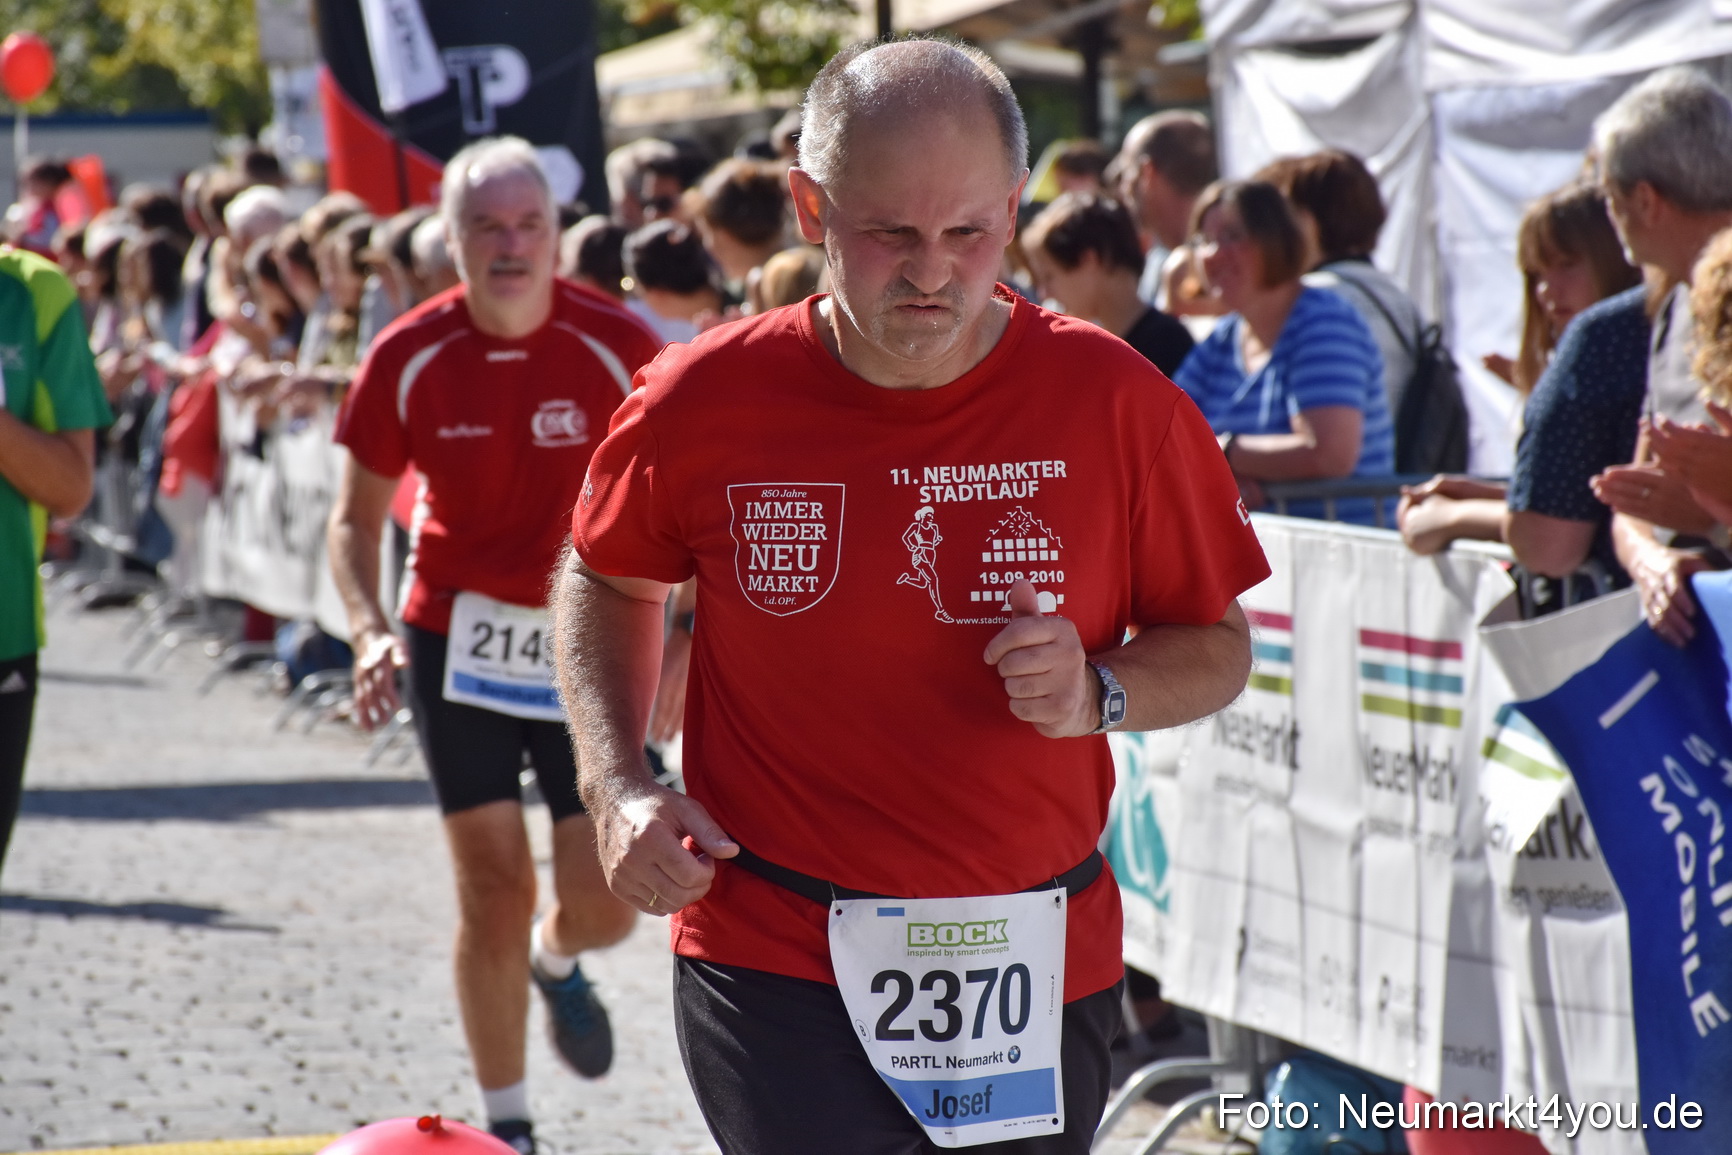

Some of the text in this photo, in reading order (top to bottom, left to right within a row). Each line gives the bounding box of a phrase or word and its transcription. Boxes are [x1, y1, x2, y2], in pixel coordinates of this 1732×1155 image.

[890, 460, 1067, 485] 11. NEUMARKTER
[761, 489, 807, 498] 850 Jahre
[919, 480, 1039, 503] STADTLAUF
[745, 501, 824, 519] IMMER
[741, 523, 827, 541] WIEDER
[748, 543, 820, 571] NEU
[747, 574, 819, 592] MARKT
[777, 596, 797, 605] OPf.
[469, 621, 553, 667] 214
[1639, 772, 1731, 1038] MOBILE
[907, 918, 1009, 947] BOCK
[906, 946, 1010, 958] inspired by smart concepts
[870, 963, 1031, 1042] 2370
[890, 1052, 1004, 1069] PARTL Neumarkt
[924, 1084, 993, 1119] Josef
